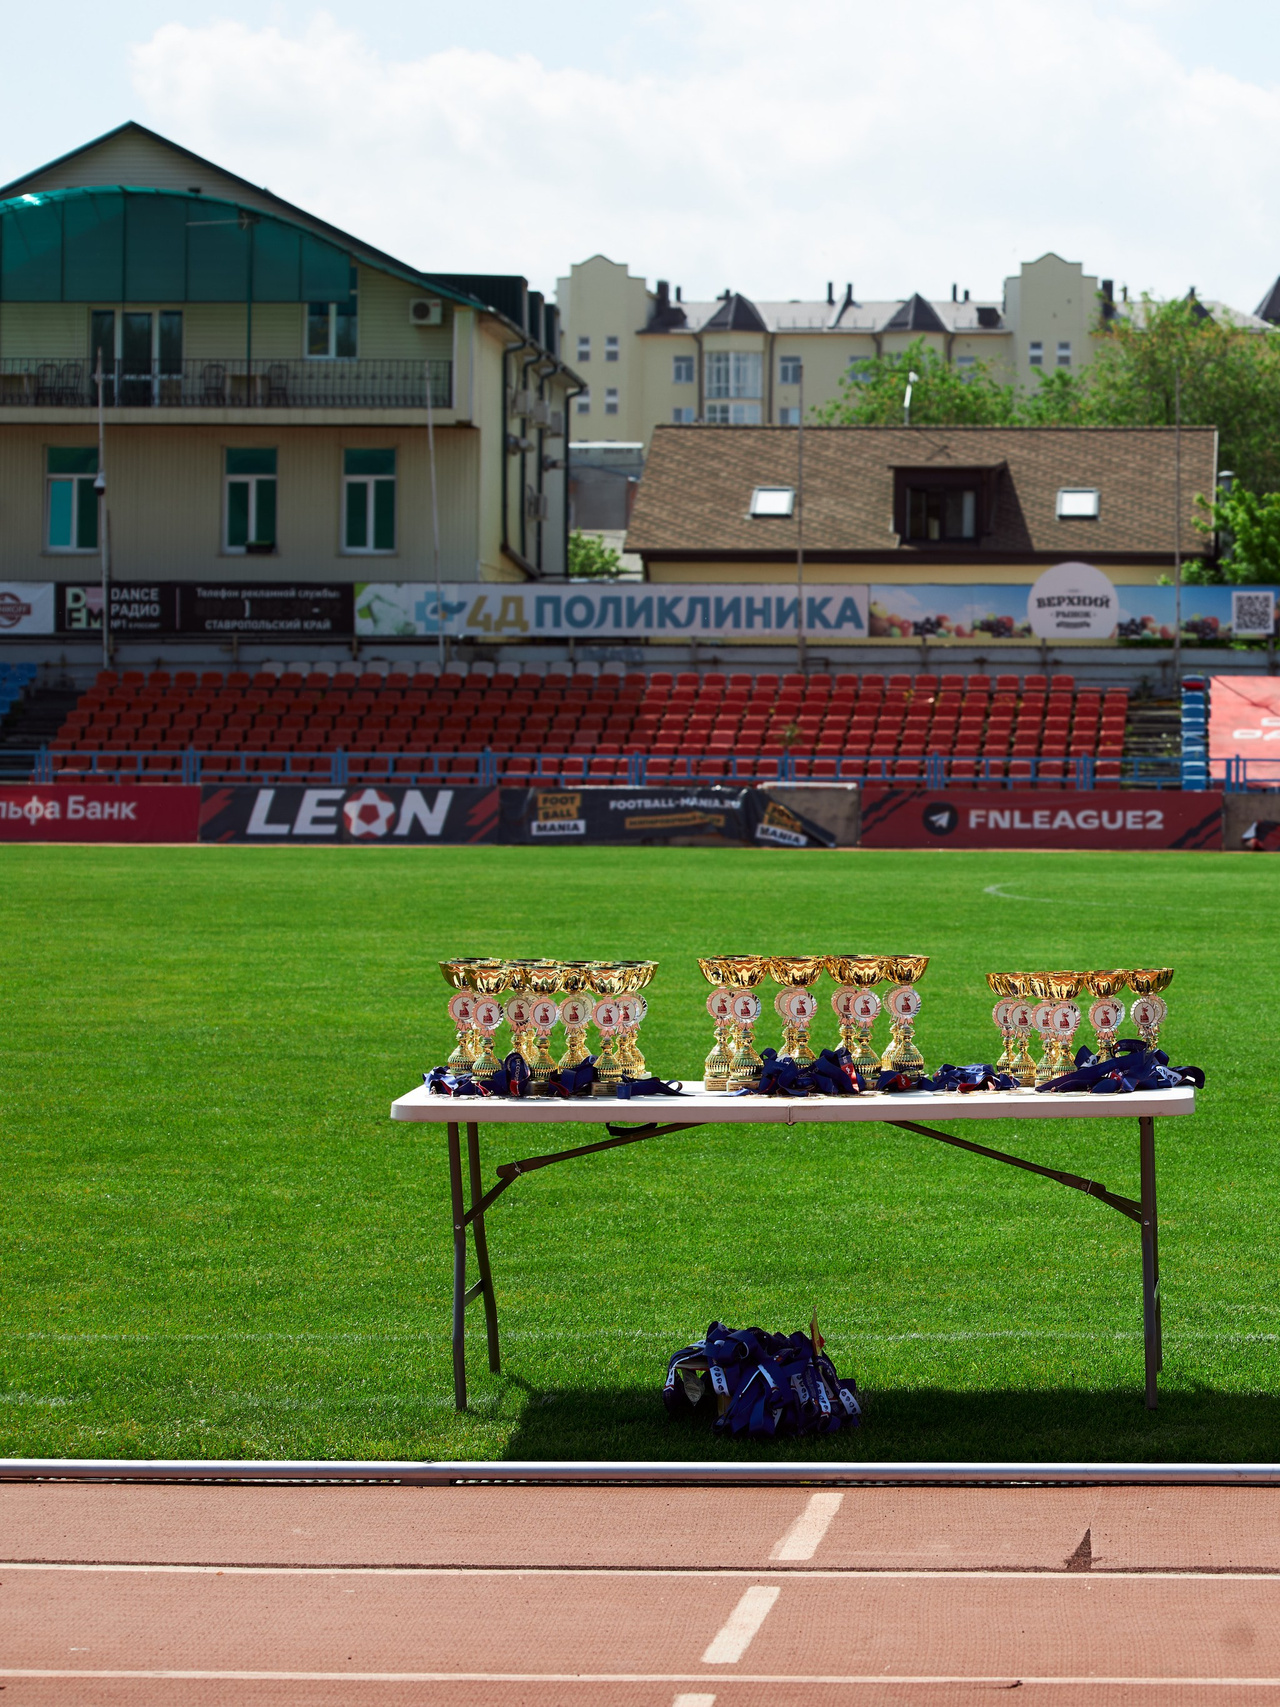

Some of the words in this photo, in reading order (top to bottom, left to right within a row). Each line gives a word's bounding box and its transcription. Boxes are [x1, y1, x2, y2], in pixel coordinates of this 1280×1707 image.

[111, 588, 159, 600] DANCE
[196, 587, 239, 599] Телефон
[241, 588, 296, 599] рекламной
[1036, 594, 1111, 608] ВЕРХНИЙ
[111, 603, 160, 617] РАДИО
[465, 595, 529, 632] 4Д
[535, 595, 865, 631] ПОЛИКЛИНИКА
[1055, 610, 1091, 618] РЫНОК
[205, 618, 301, 630] СТАВРОПОЛЬСКИЙ
[303, 618, 332, 630] КРАЙ
[541, 795, 576, 806] FOOT
[609, 797, 741, 810] FOOTBALL-MANIA.RU
[66, 795, 138, 821] Банк
[246, 788, 454, 839] LEON
[542, 809, 574, 819] BALL
[968, 809, 1165, 830] FNLEAGUE2
[535, 822, 580, 833] MANIA
[759, 826, 801, 844] MANIA
